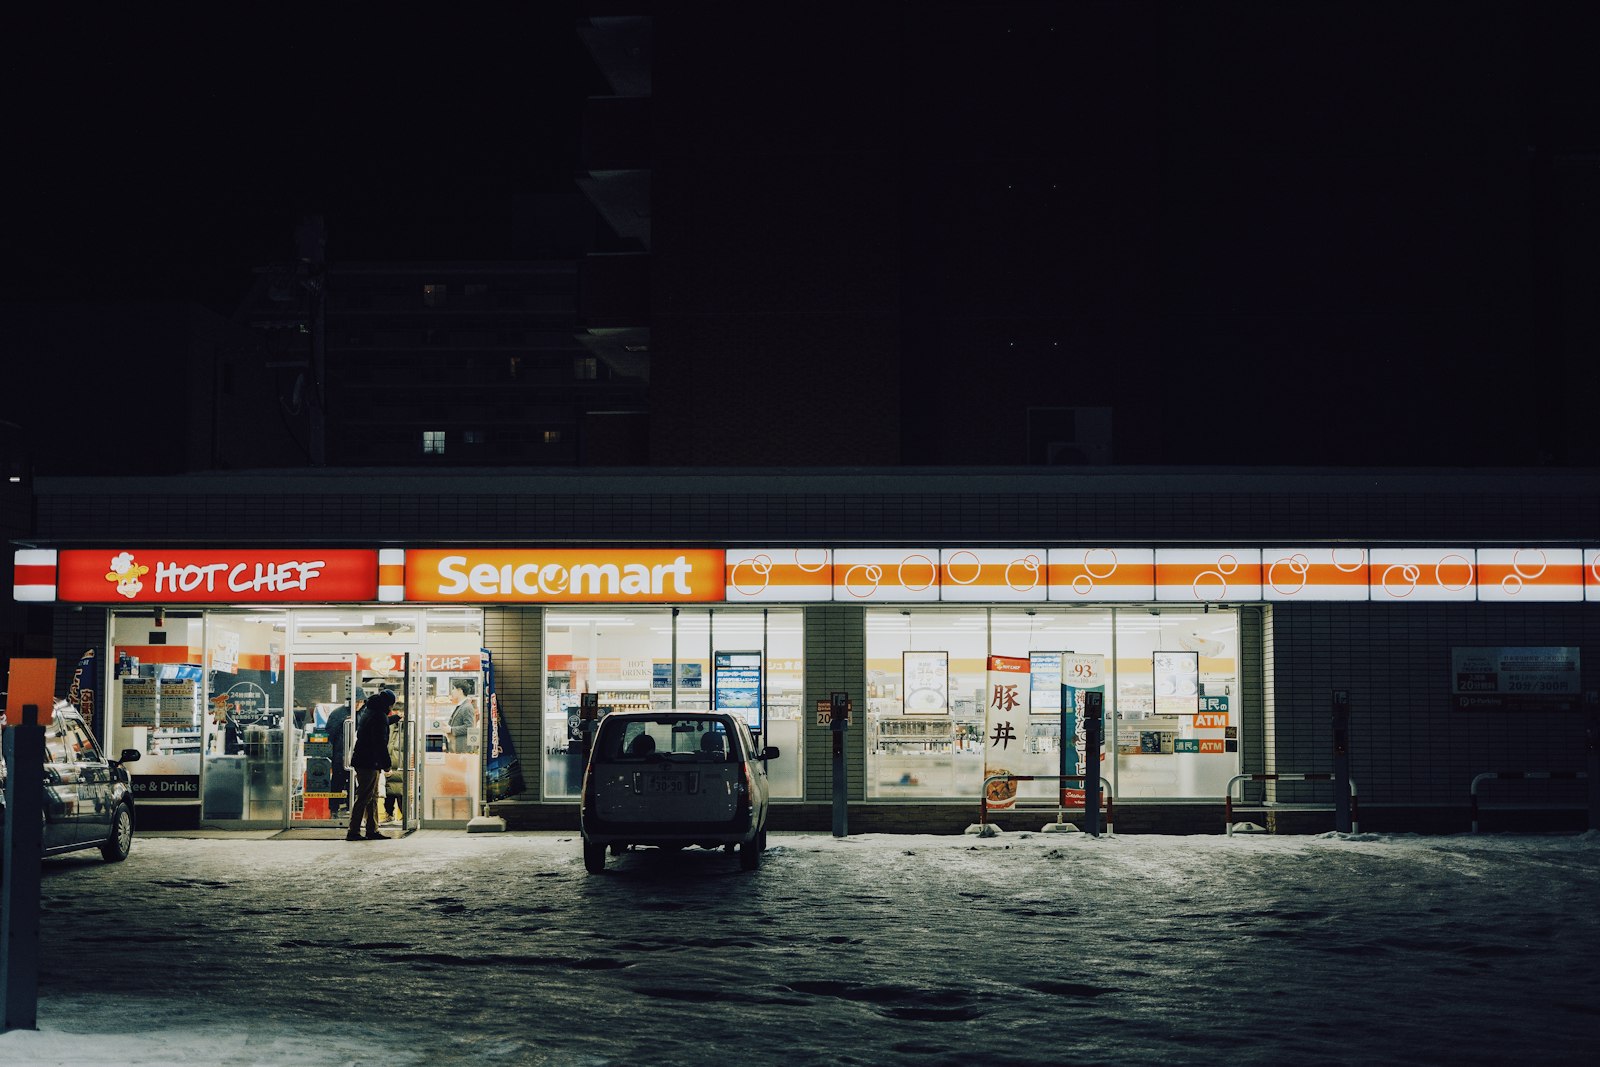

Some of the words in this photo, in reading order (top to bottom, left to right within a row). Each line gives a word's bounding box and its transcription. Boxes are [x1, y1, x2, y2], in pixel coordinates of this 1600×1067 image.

[155, 561, 228, 593] HOT
[228, 560, 326, 592] CHEF
[1195, 714, 1225, 726] ATM
[1200, 742, 1222, 751] ATM
[160, 781, 198, 791] Drinks
